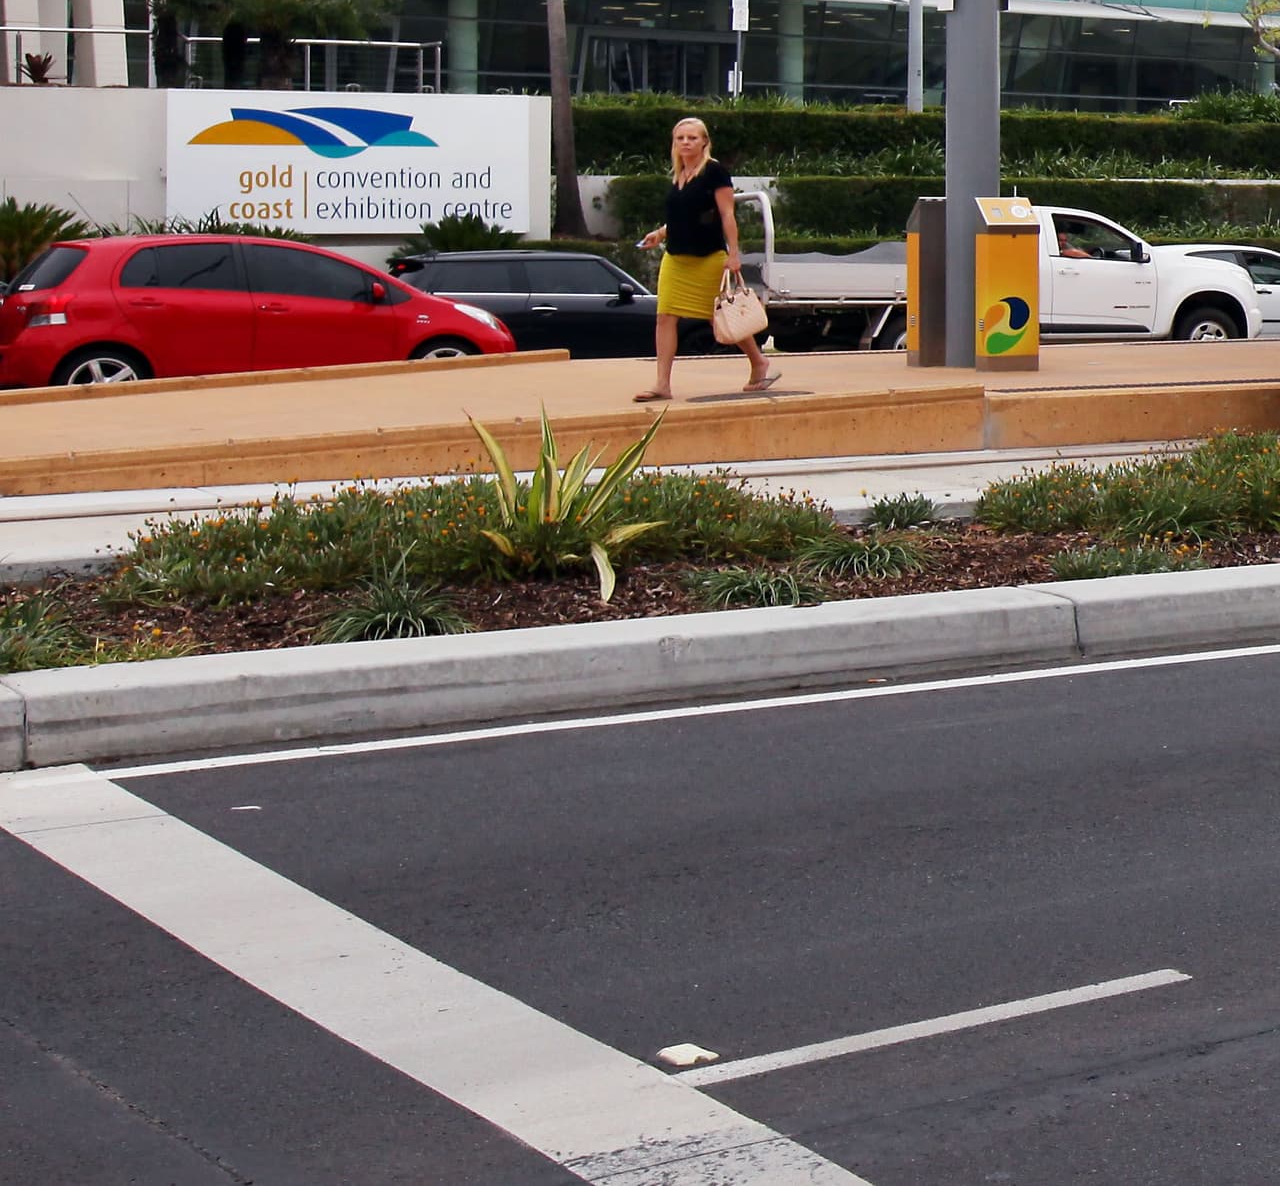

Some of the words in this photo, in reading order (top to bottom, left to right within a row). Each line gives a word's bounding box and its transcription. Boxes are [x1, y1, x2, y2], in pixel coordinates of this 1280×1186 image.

[239, 164, 293, 194] gold
[316, 166, 441, 189] convention
[451, 166, 491, 189] and
[229, 198, 293, 220] coast
[316, 196, 431, 220] exhibition
[443, 198, 512, 220] centre
